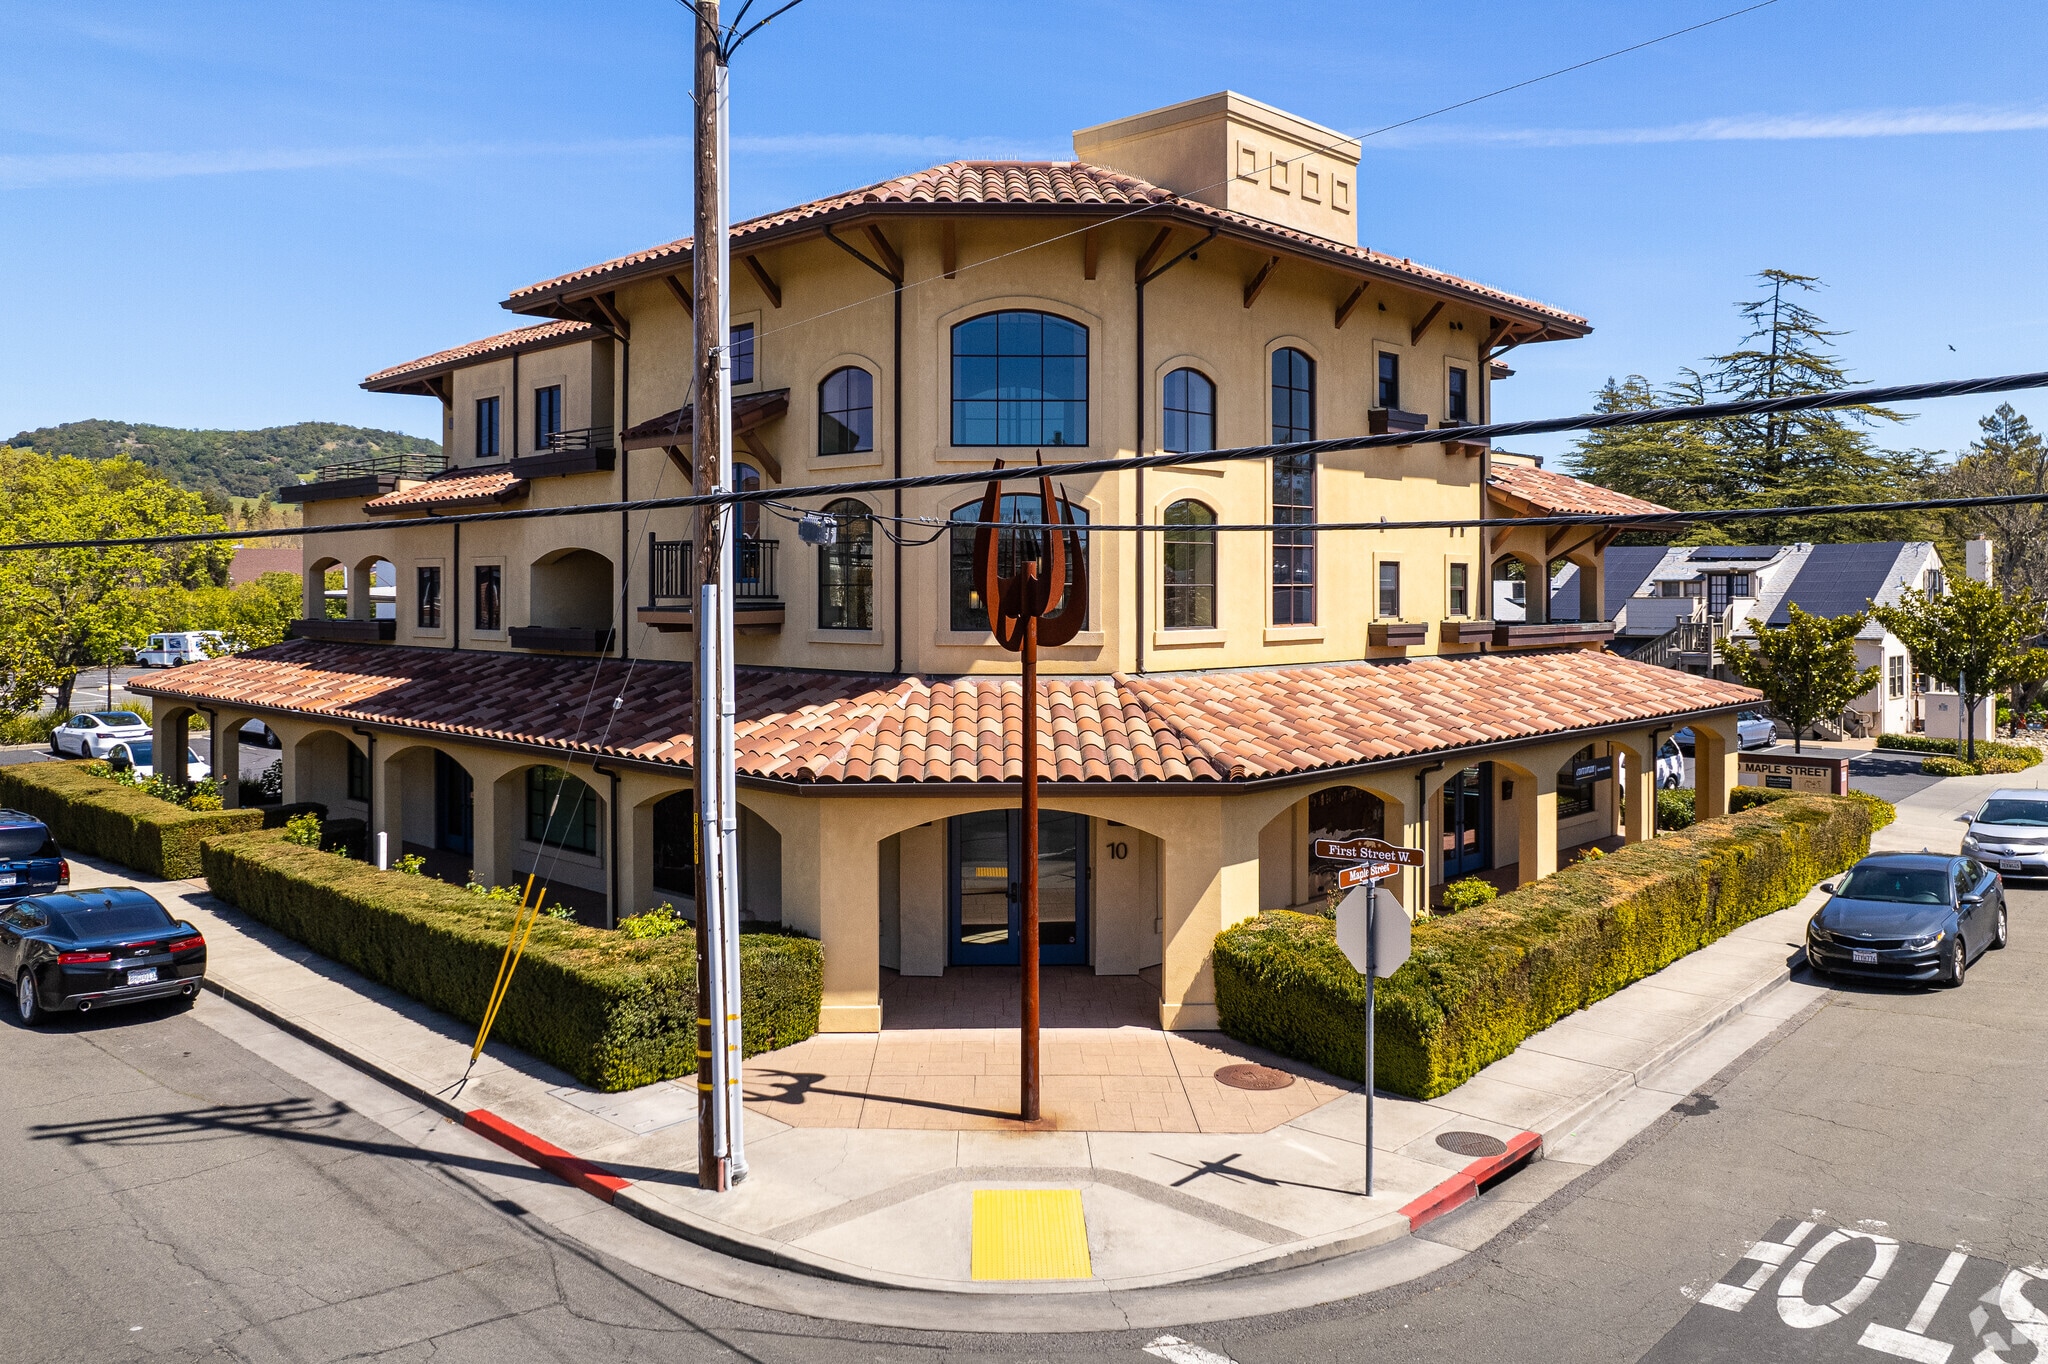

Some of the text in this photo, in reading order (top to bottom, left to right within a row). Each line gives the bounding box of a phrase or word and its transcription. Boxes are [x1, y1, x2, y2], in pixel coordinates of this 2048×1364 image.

[1745, 763, 1781, 774] MAPLE
[1786, 765, 1829, 777] STREET
[1106, 842, 1128, 860] 10
[1328, 844, 1411, 862] First Street W.
[1349, 863, 1390, 881] Maple Street
